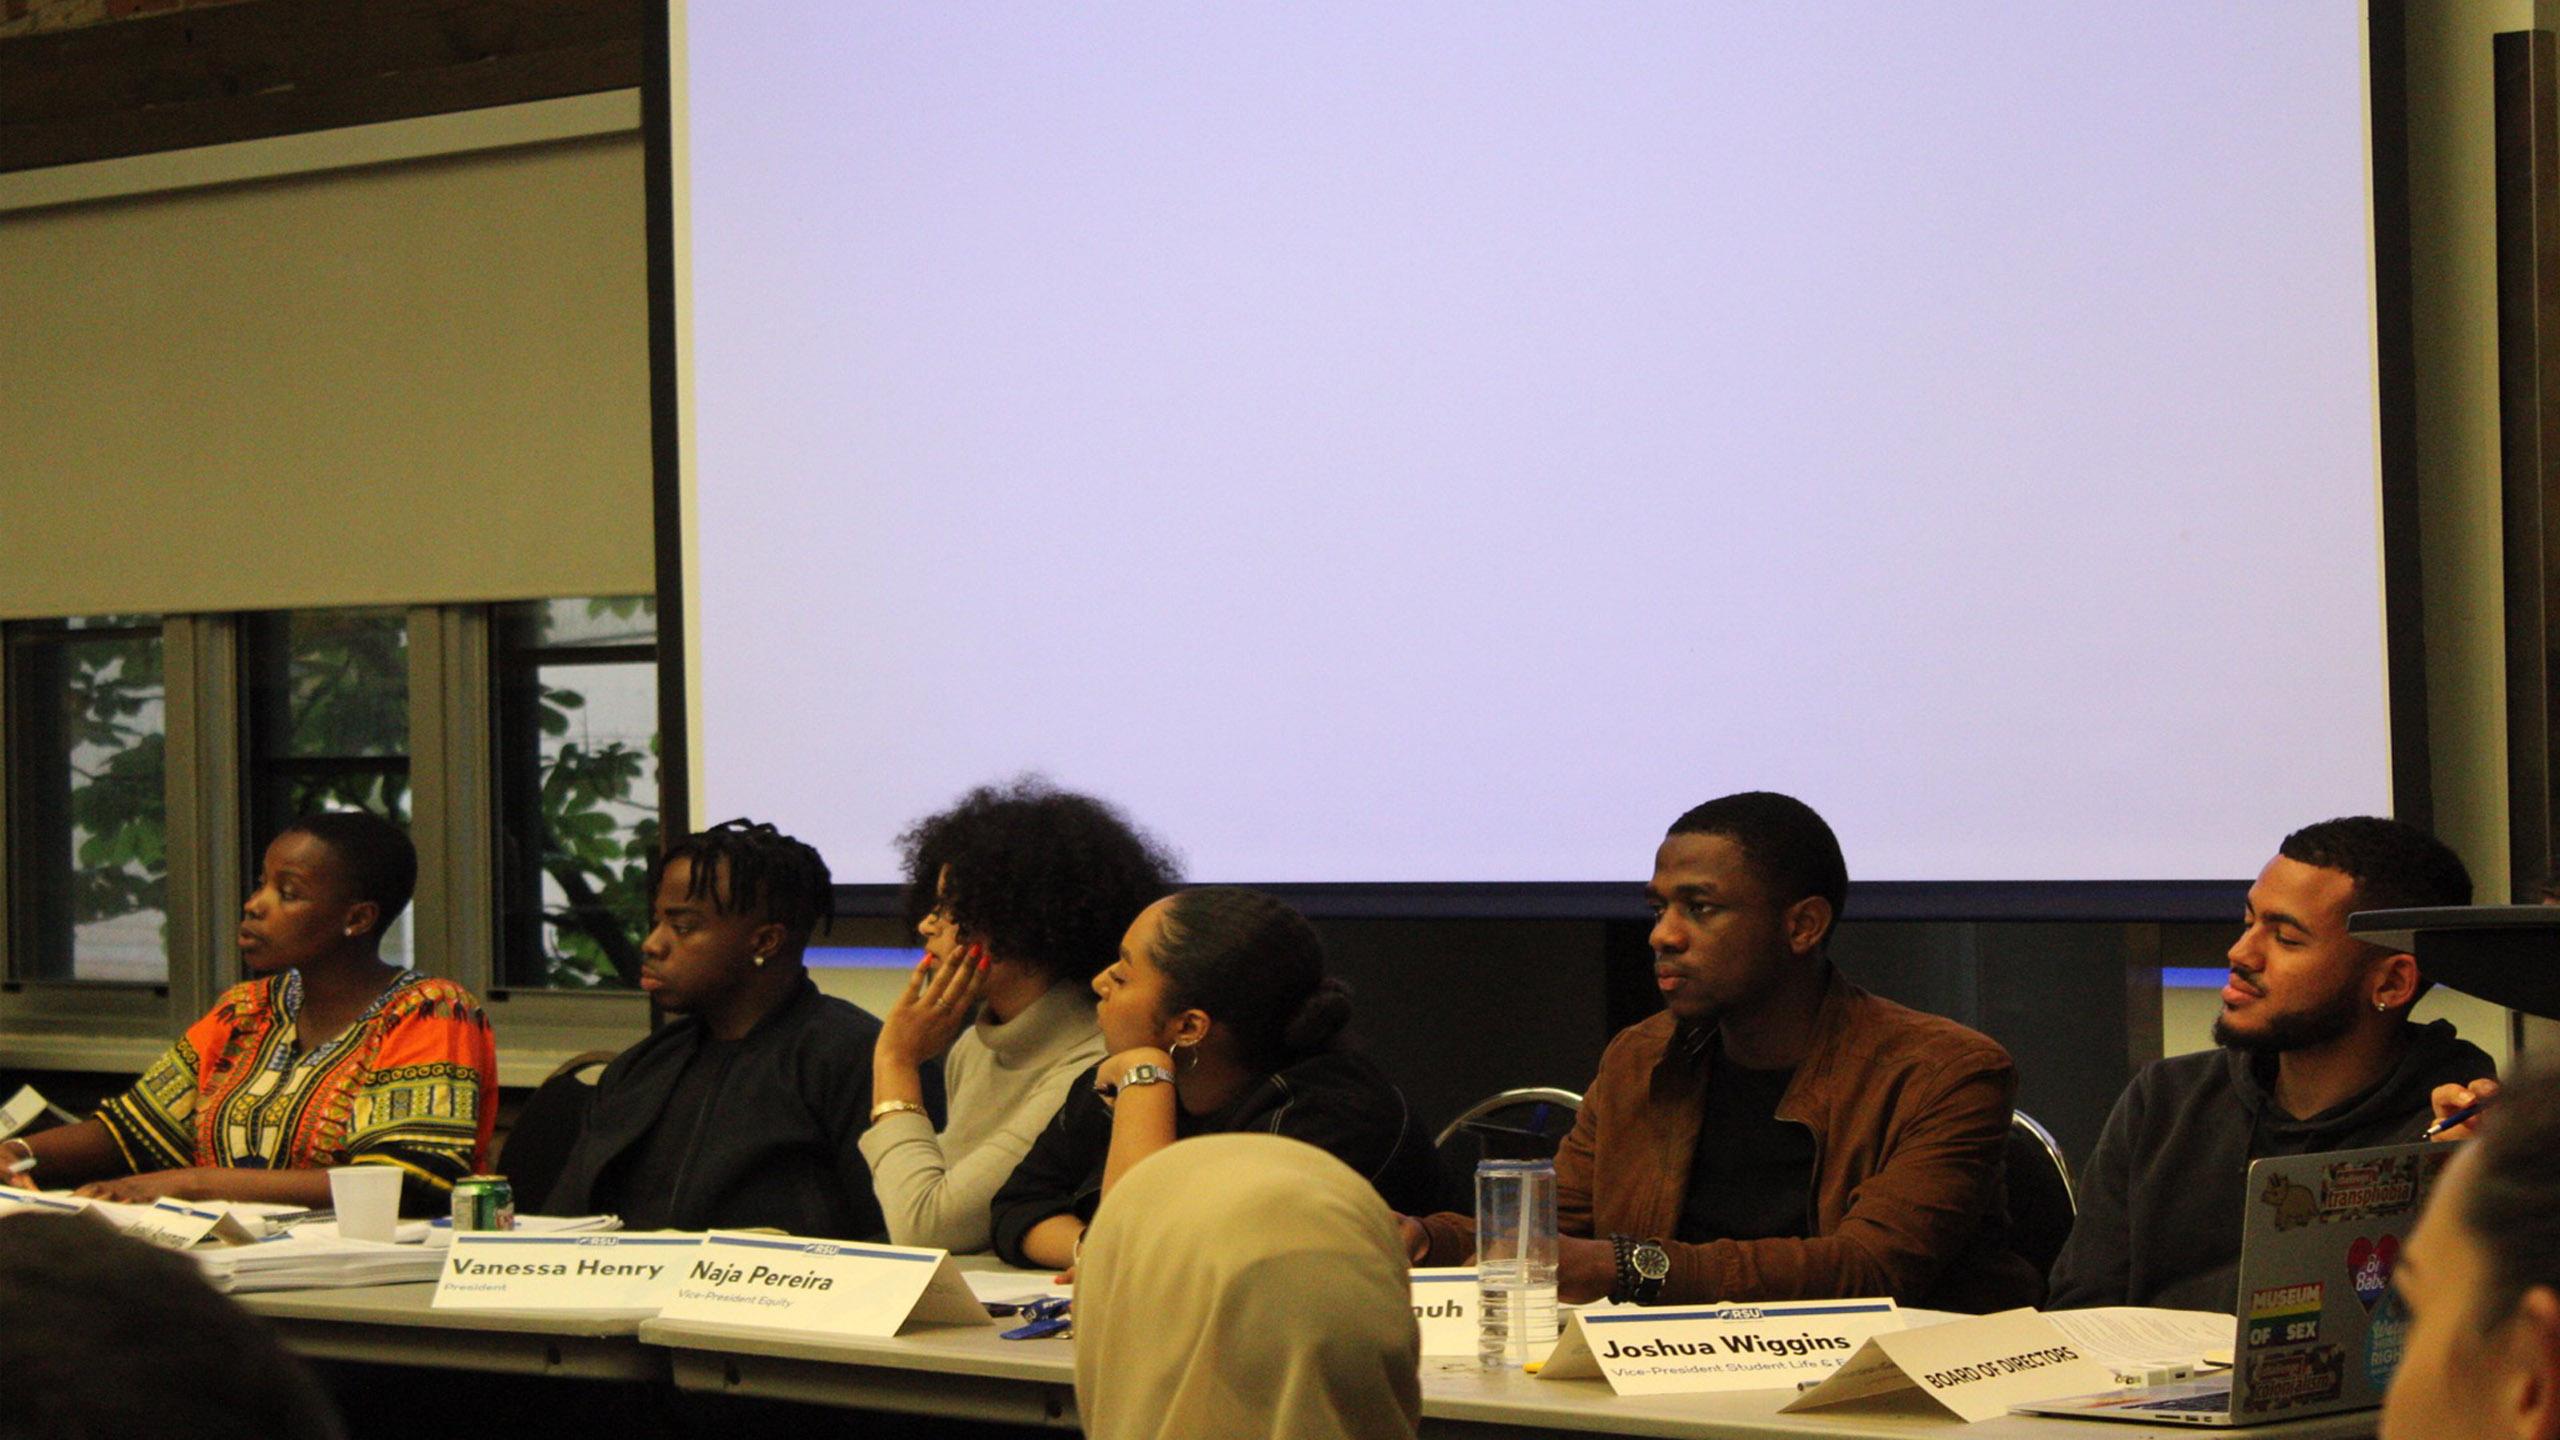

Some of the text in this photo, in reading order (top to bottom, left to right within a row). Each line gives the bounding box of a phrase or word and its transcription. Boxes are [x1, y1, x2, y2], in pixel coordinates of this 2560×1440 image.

[453, 1258, 664, 1280] Vanessa Henry
[689, 1260, 834, 1291] Naja Pereira
[444, 1283, 507, 1292] President
[678, 1288, 794, 1309] Vice-President Equity
[2252, 1285, 2320, 1310] MUSEUM
[2250, 1320, 2317, 1345] OF SEX
[1603, 1332, 1851, 1359] Joshua Wiggins
[1611, 1363, 1723, 1377] Vice-President
[1725, 1361, 1787, 1374] Student
[1789, 1359, 1818, 1369] Life
[1820, 1358, 1833, 1368] &
[1924, 1365, 1983, 1389] BOARD
[1978, 1361, 2004, 1378] OF
[2002, 1346, 2080, 1373] DIRECTORS
